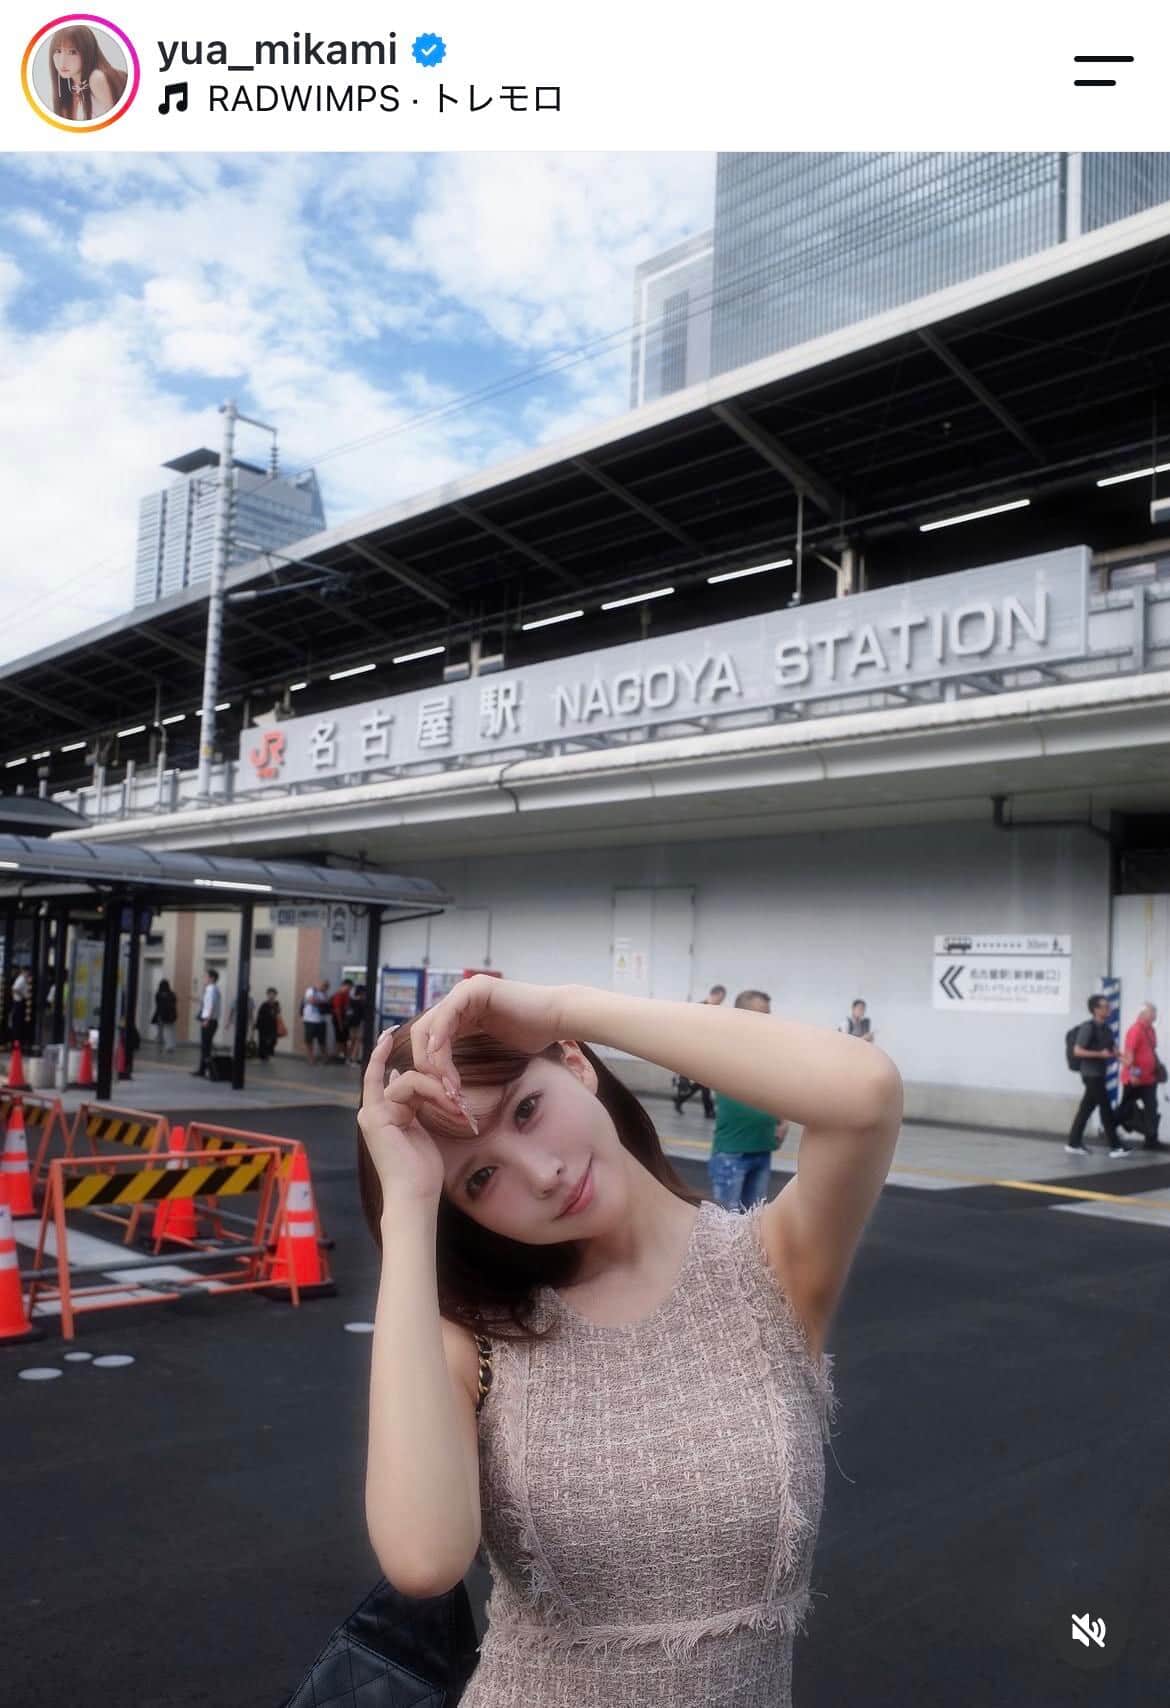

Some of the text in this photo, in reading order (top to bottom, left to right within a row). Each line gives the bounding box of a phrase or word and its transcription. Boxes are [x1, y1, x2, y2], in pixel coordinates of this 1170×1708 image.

[555, 591, 1050, 724] NAGOYA STATION
[250, 729, 286, 768] JR
[309, 679, 523, 769] 名古屋駅
